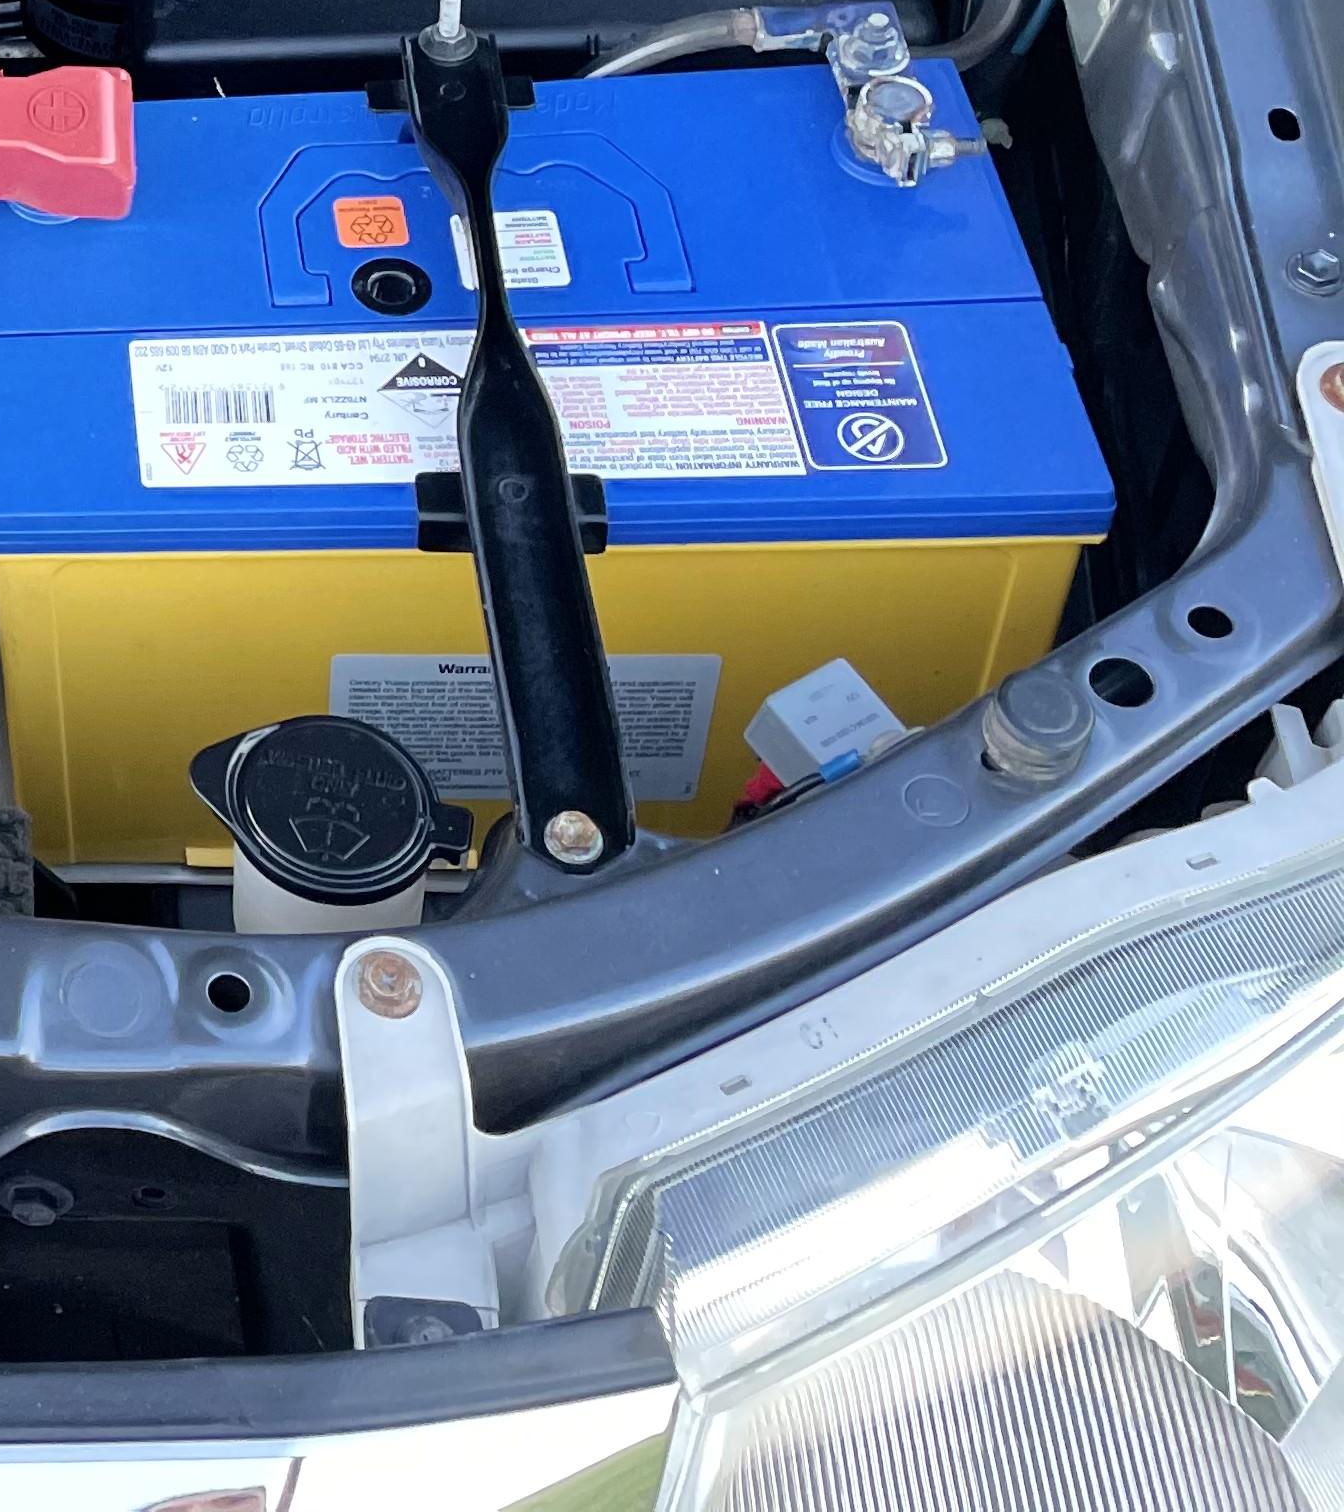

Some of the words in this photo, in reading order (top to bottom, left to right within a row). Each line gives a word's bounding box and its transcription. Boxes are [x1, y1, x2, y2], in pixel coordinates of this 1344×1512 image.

[248, 103, 372, 130] ustralia
[522, 265, 561, 274] Charge
[510, 276, 539, 285] State
[308, 340, 333, 352] Cobalt
[357, 339, 371, 350] Ltd
[372, 337, 386, 349] Pty
[387, 337, 419, 349] Batteries
[420, 336, 445, 348] Yuasa
[797, 340, 828, 350] Made
[831, 337, 886, 349] Australian
[134, 346, 148, 358] 232
[192, 344, 209, 356] ABN
[210, 344, 229, 356] 4300
[239, 343, 256, 355] Park
[257, 342, 281, 354] Carole
[369, 353, 390, 363] 2794
[824, 349, 865, 360] Proudly
[155, 364, 173, 372] 12V
[340, 362, 364, 370] CCA
[395, 375, 458, 387] CORROSIVE
[836, 388, 879, 397] DESIGN
[803, 399, 833, 409] FREE
[835, 398, 918, 407] MAINTENANCE
[324, 411, 369, 420] Century
[569, 420, 611, 430] POISON
[736, 416, 788, 426] WARNING
[294, 428, 314, 438] Pb
[369, 432, 410, 443] ELECTRIC
[336, 445, 357, 455] ACID
[358, 444, 381, 454] WITH
[383, 443, 412, 453] FILLED
[675, 461, 742, 470] INFORMATION
[745, 460, 801, 469] WARRANTY
[438, 663, 492, 675] Warra
